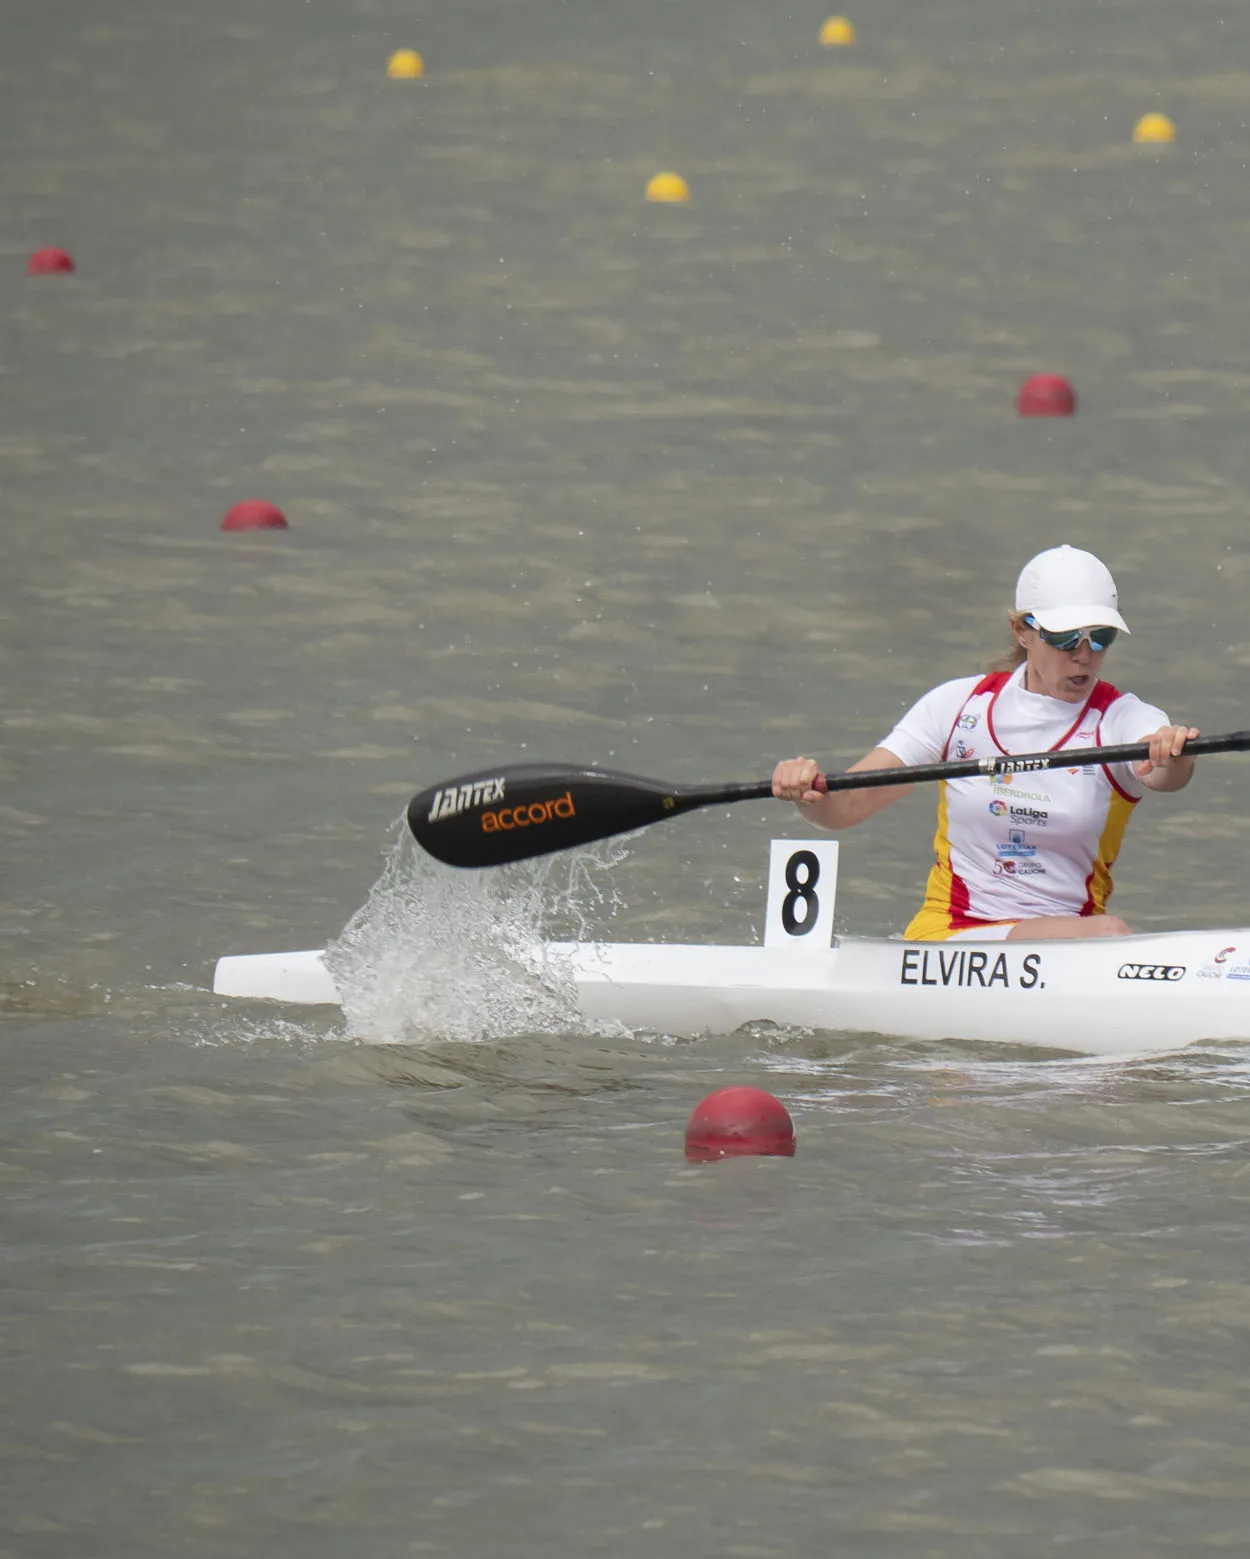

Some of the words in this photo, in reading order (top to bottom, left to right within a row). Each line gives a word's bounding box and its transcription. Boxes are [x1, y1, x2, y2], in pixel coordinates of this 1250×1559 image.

[481, 792, 576, 833] accord
[1009, 814, 1048, 827] Sports
[1010, 806, 1048, 819] LaLiga
[782, 850, 820, 936] 8
[900, 949, 1009, 987] ELVIRA
[1019, 953, 1046, 988] S.
[1121, 965, 1183, 980] NELO
